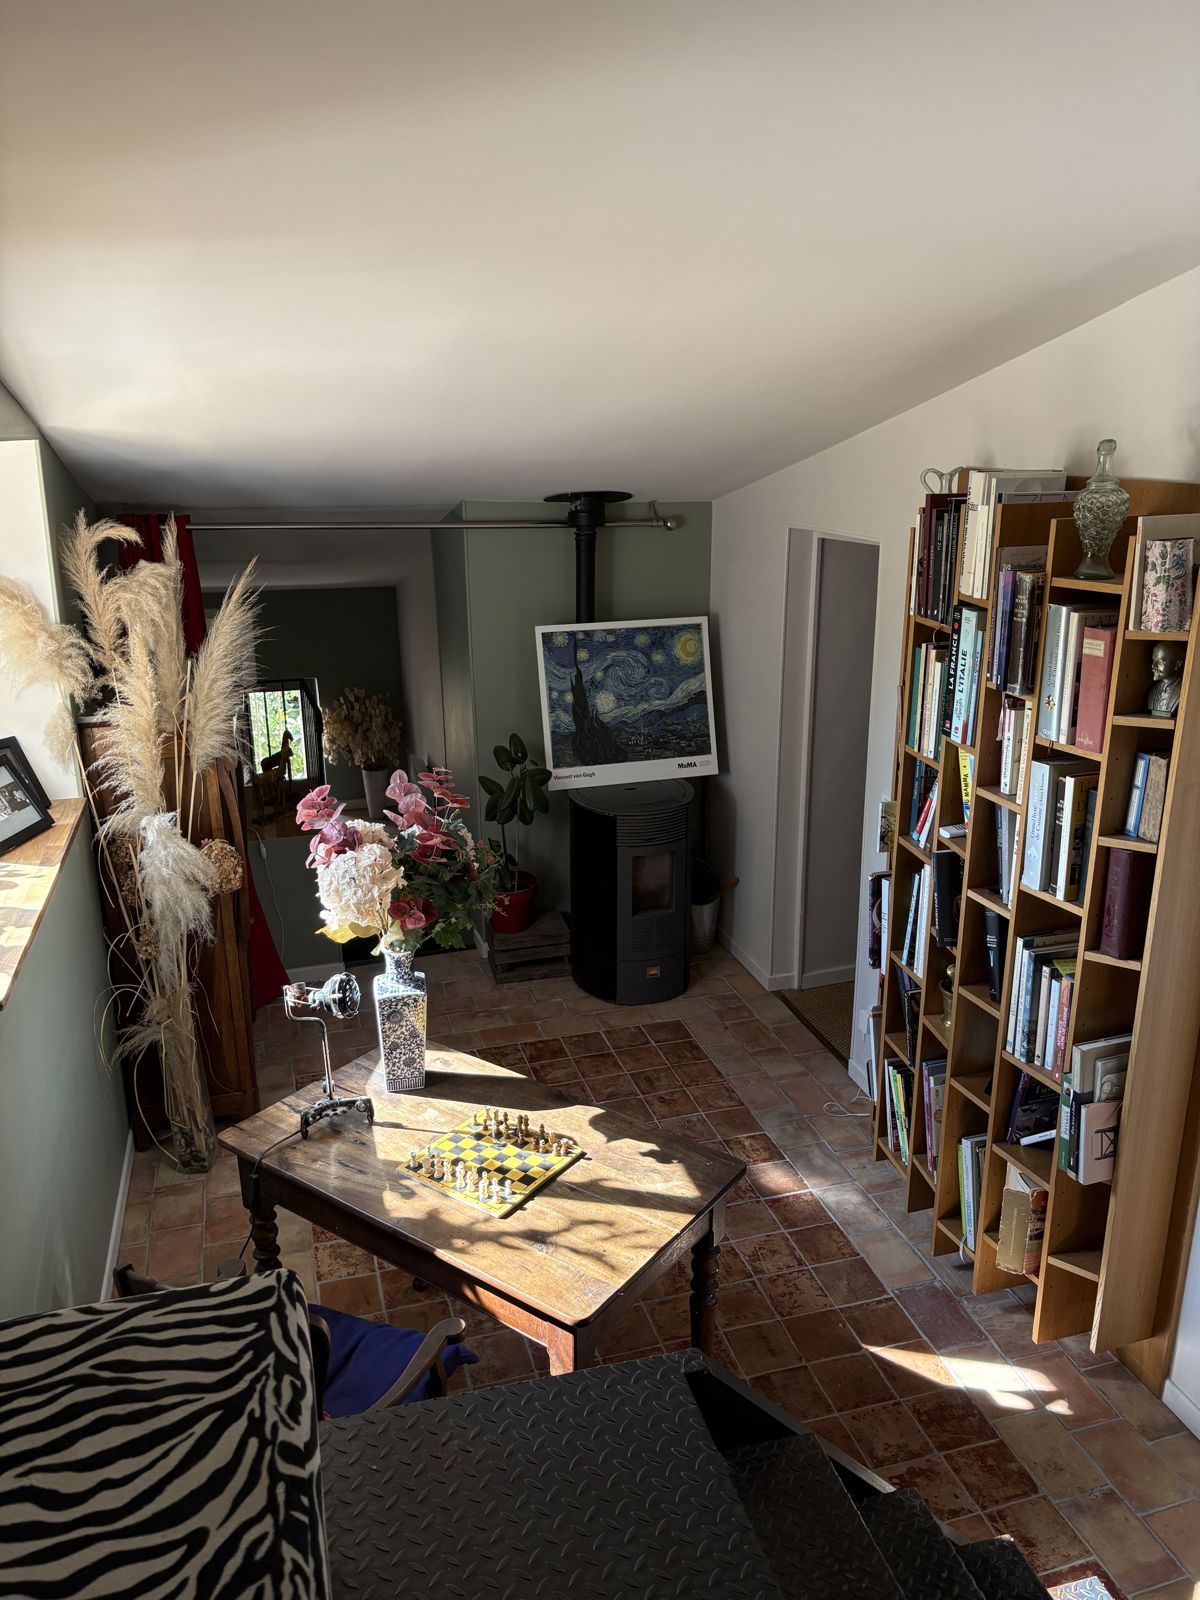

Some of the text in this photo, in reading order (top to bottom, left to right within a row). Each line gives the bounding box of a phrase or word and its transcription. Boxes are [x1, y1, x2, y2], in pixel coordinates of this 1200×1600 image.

[950, 634, 958, 672] FRANCE
[948, 675, 954, 689] LA
[958, 649, 968, 694] L'ITALIE
[553, 772, 572, 780] Vincent
[582, 771, 596, 779] Gogh
